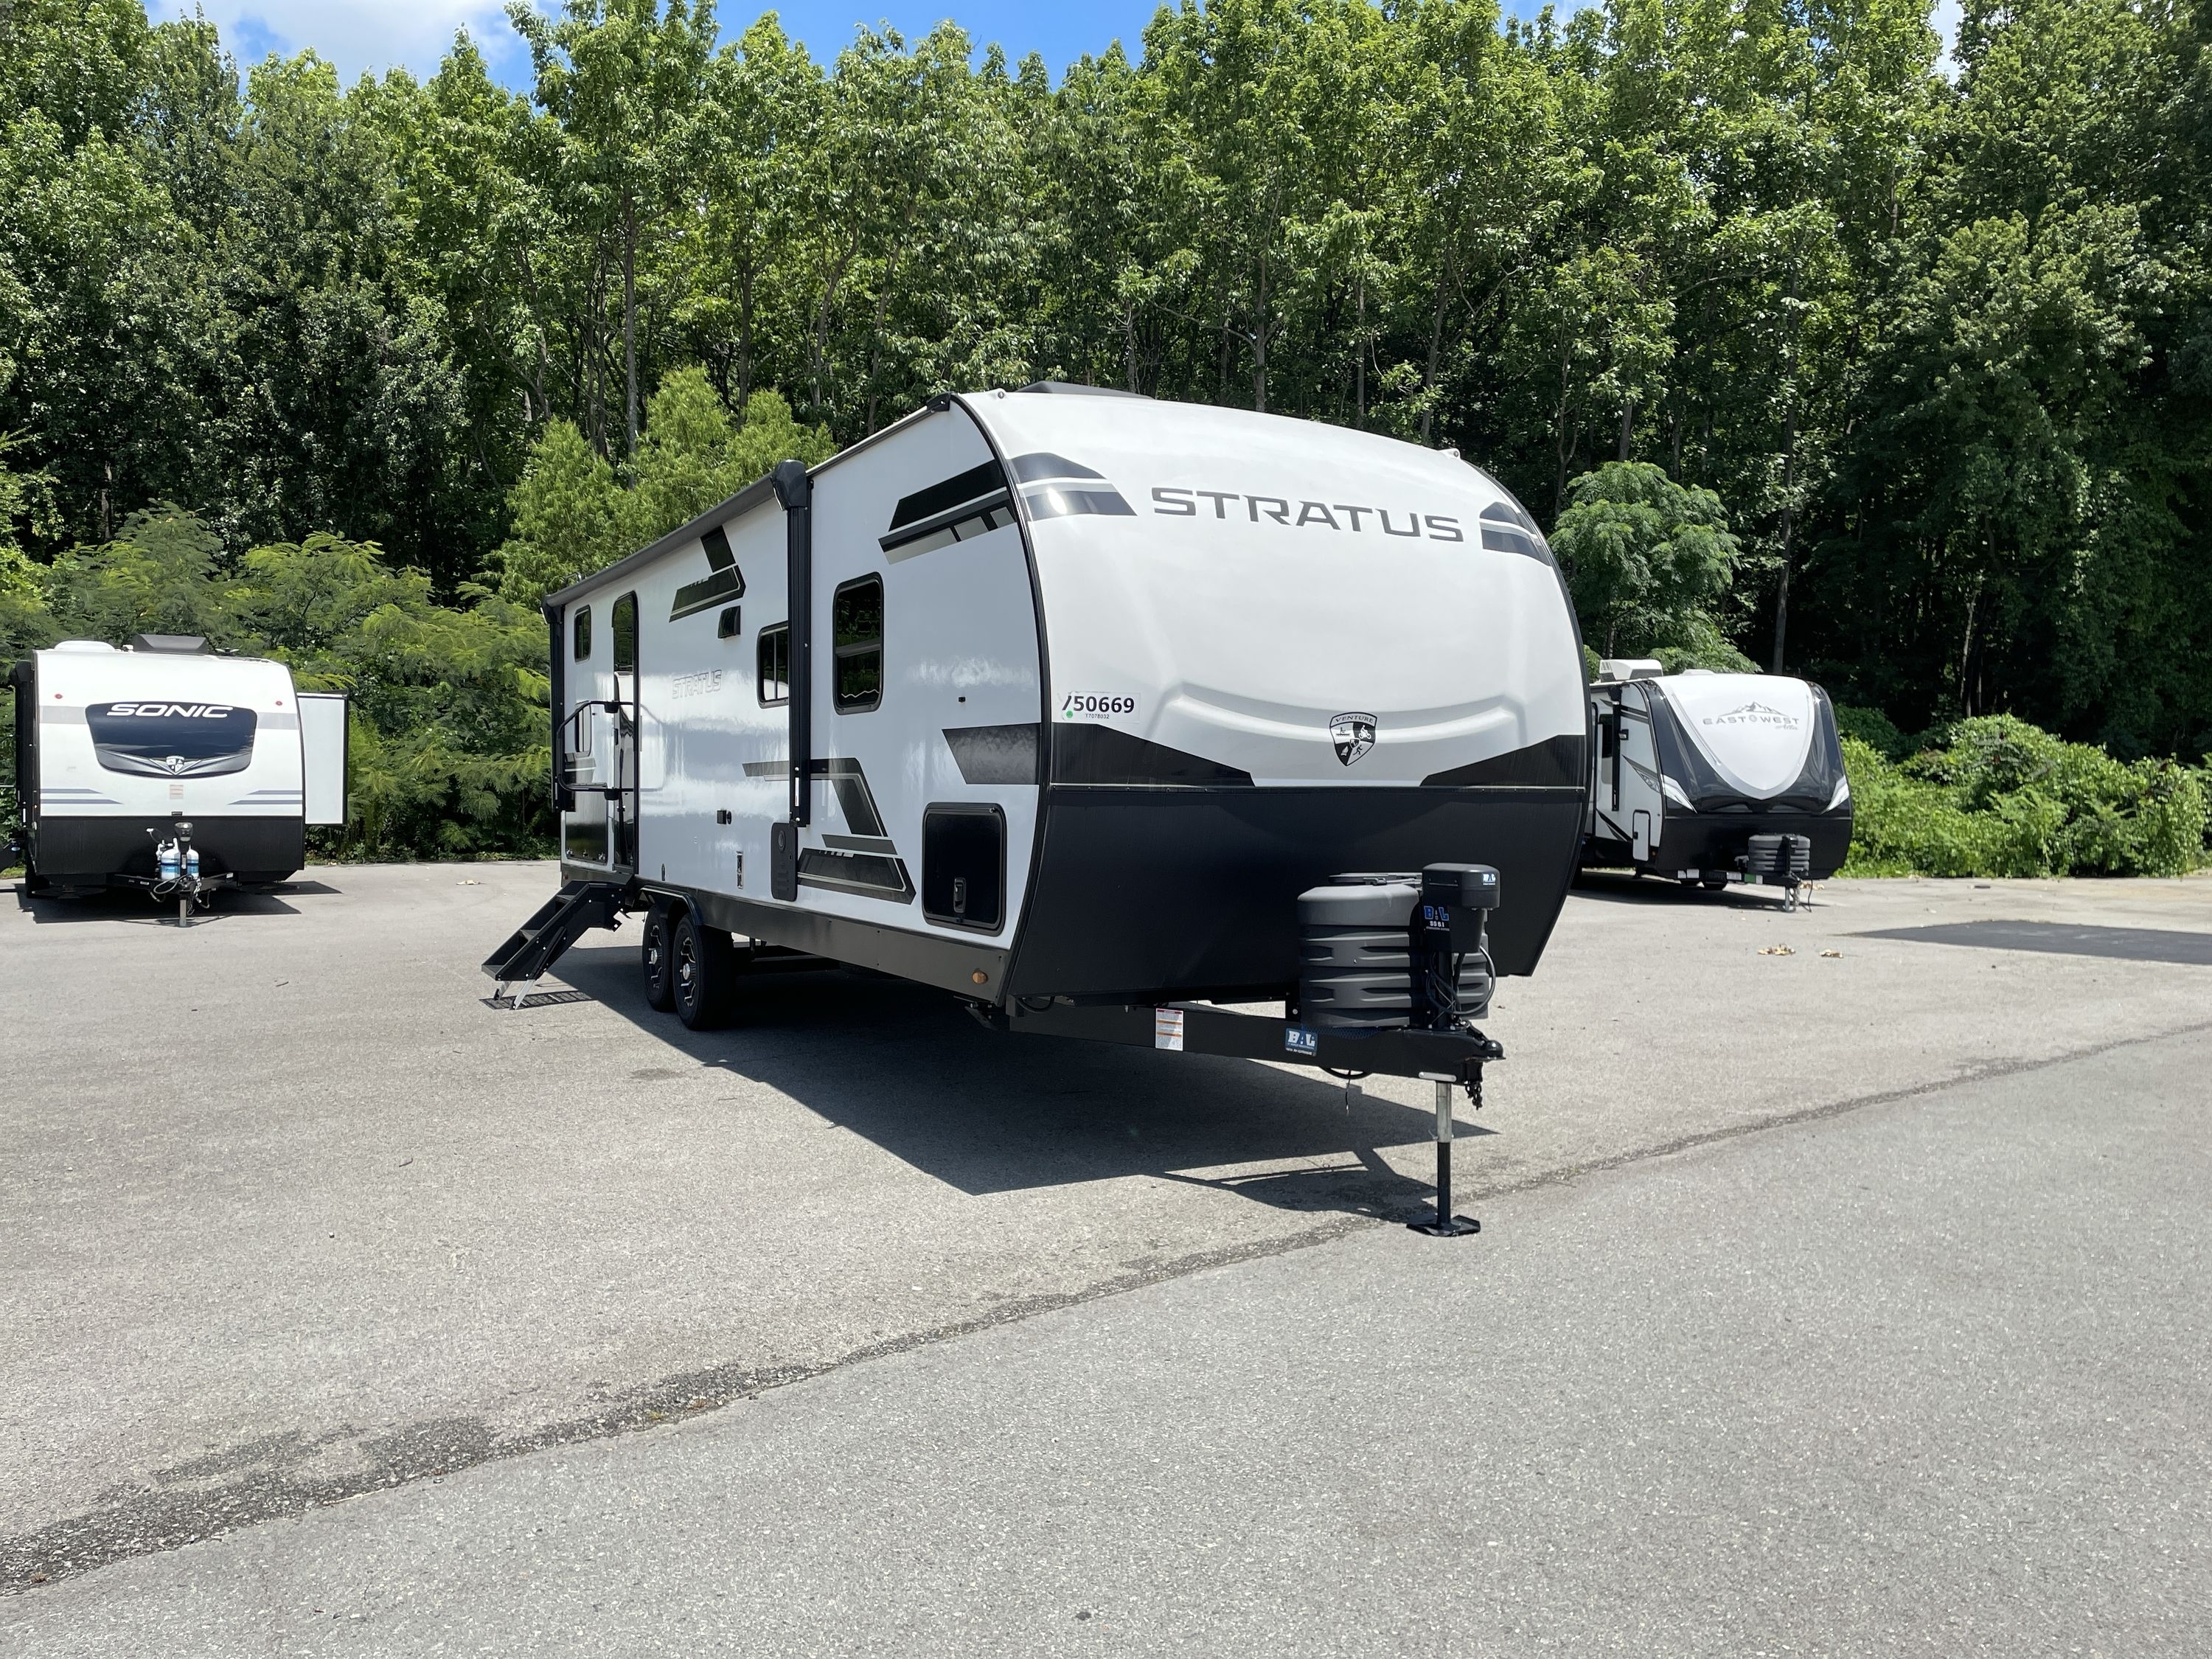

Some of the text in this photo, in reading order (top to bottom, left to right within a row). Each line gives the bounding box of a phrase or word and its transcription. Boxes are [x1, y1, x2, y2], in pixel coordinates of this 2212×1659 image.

[1152, 487, 1464, 542] STRATUS
[672, 669, 722, 700] STRATUS
[107, 703, 233, 718] SONIC
[1335, 715, 1374, 723] VENTURE
